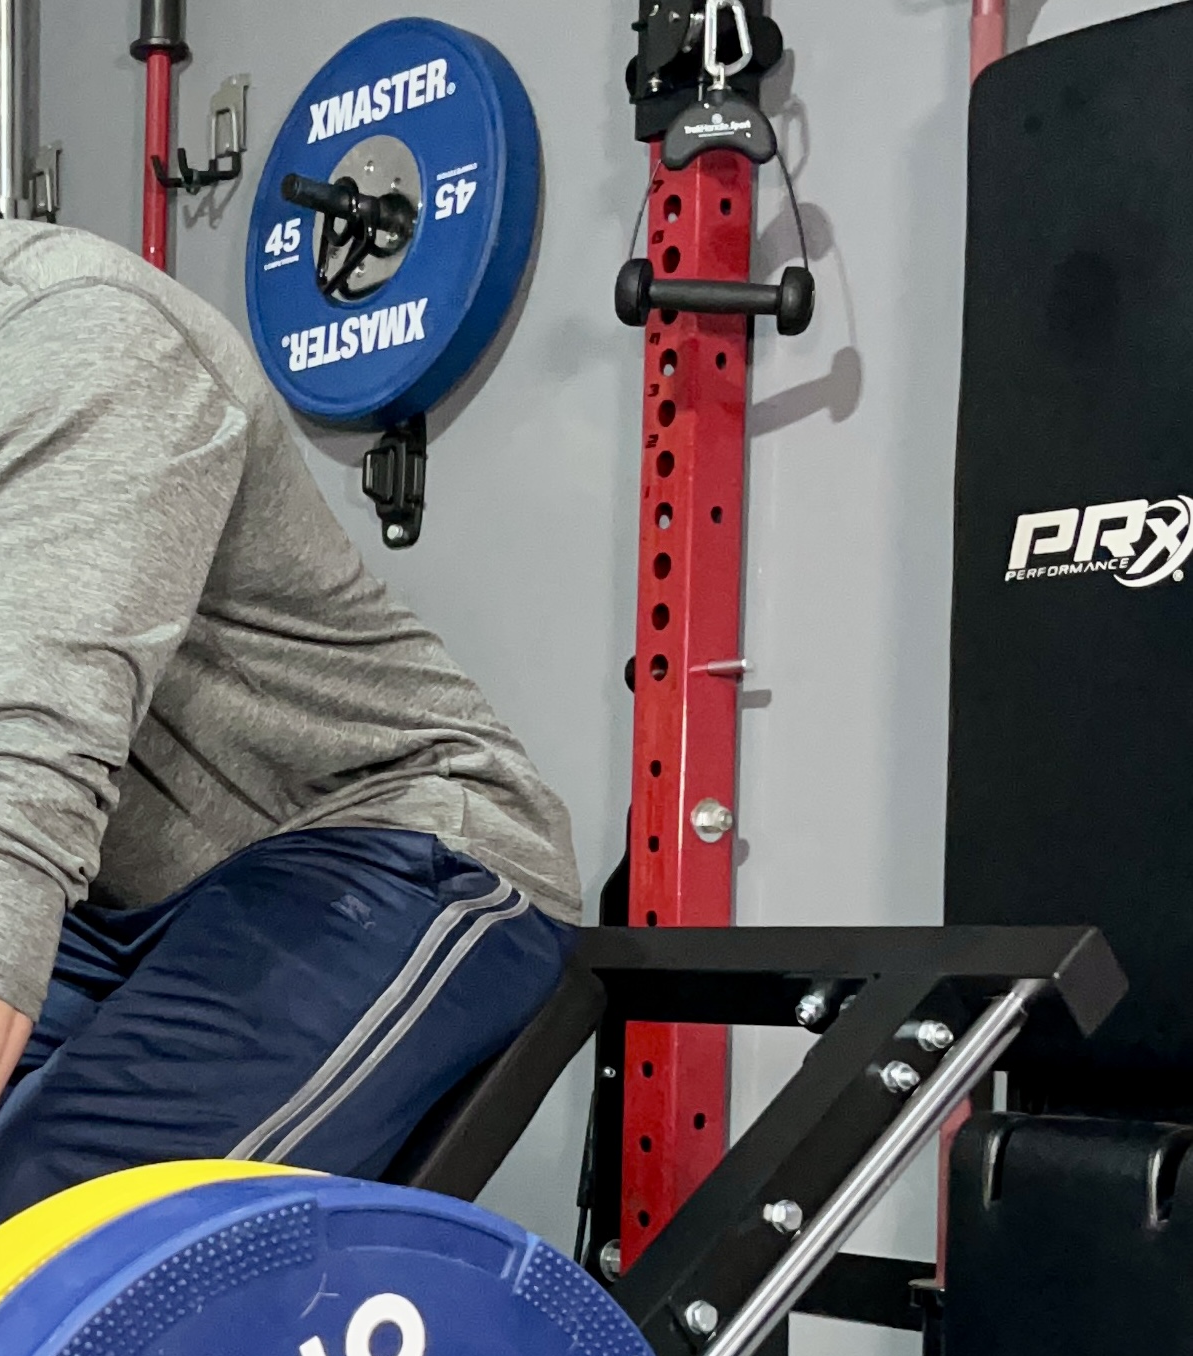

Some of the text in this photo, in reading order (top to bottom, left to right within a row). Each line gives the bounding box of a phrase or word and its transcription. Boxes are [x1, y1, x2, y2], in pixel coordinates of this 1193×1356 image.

[307, 59, 448, 144] XMASTER
[435, 180, 478, 220] 45
[264, 217, 301, 256] 45
[289, 298, 428, 372] XMASTER
[1004, 557, 1130, 582] PERFORMANCE
